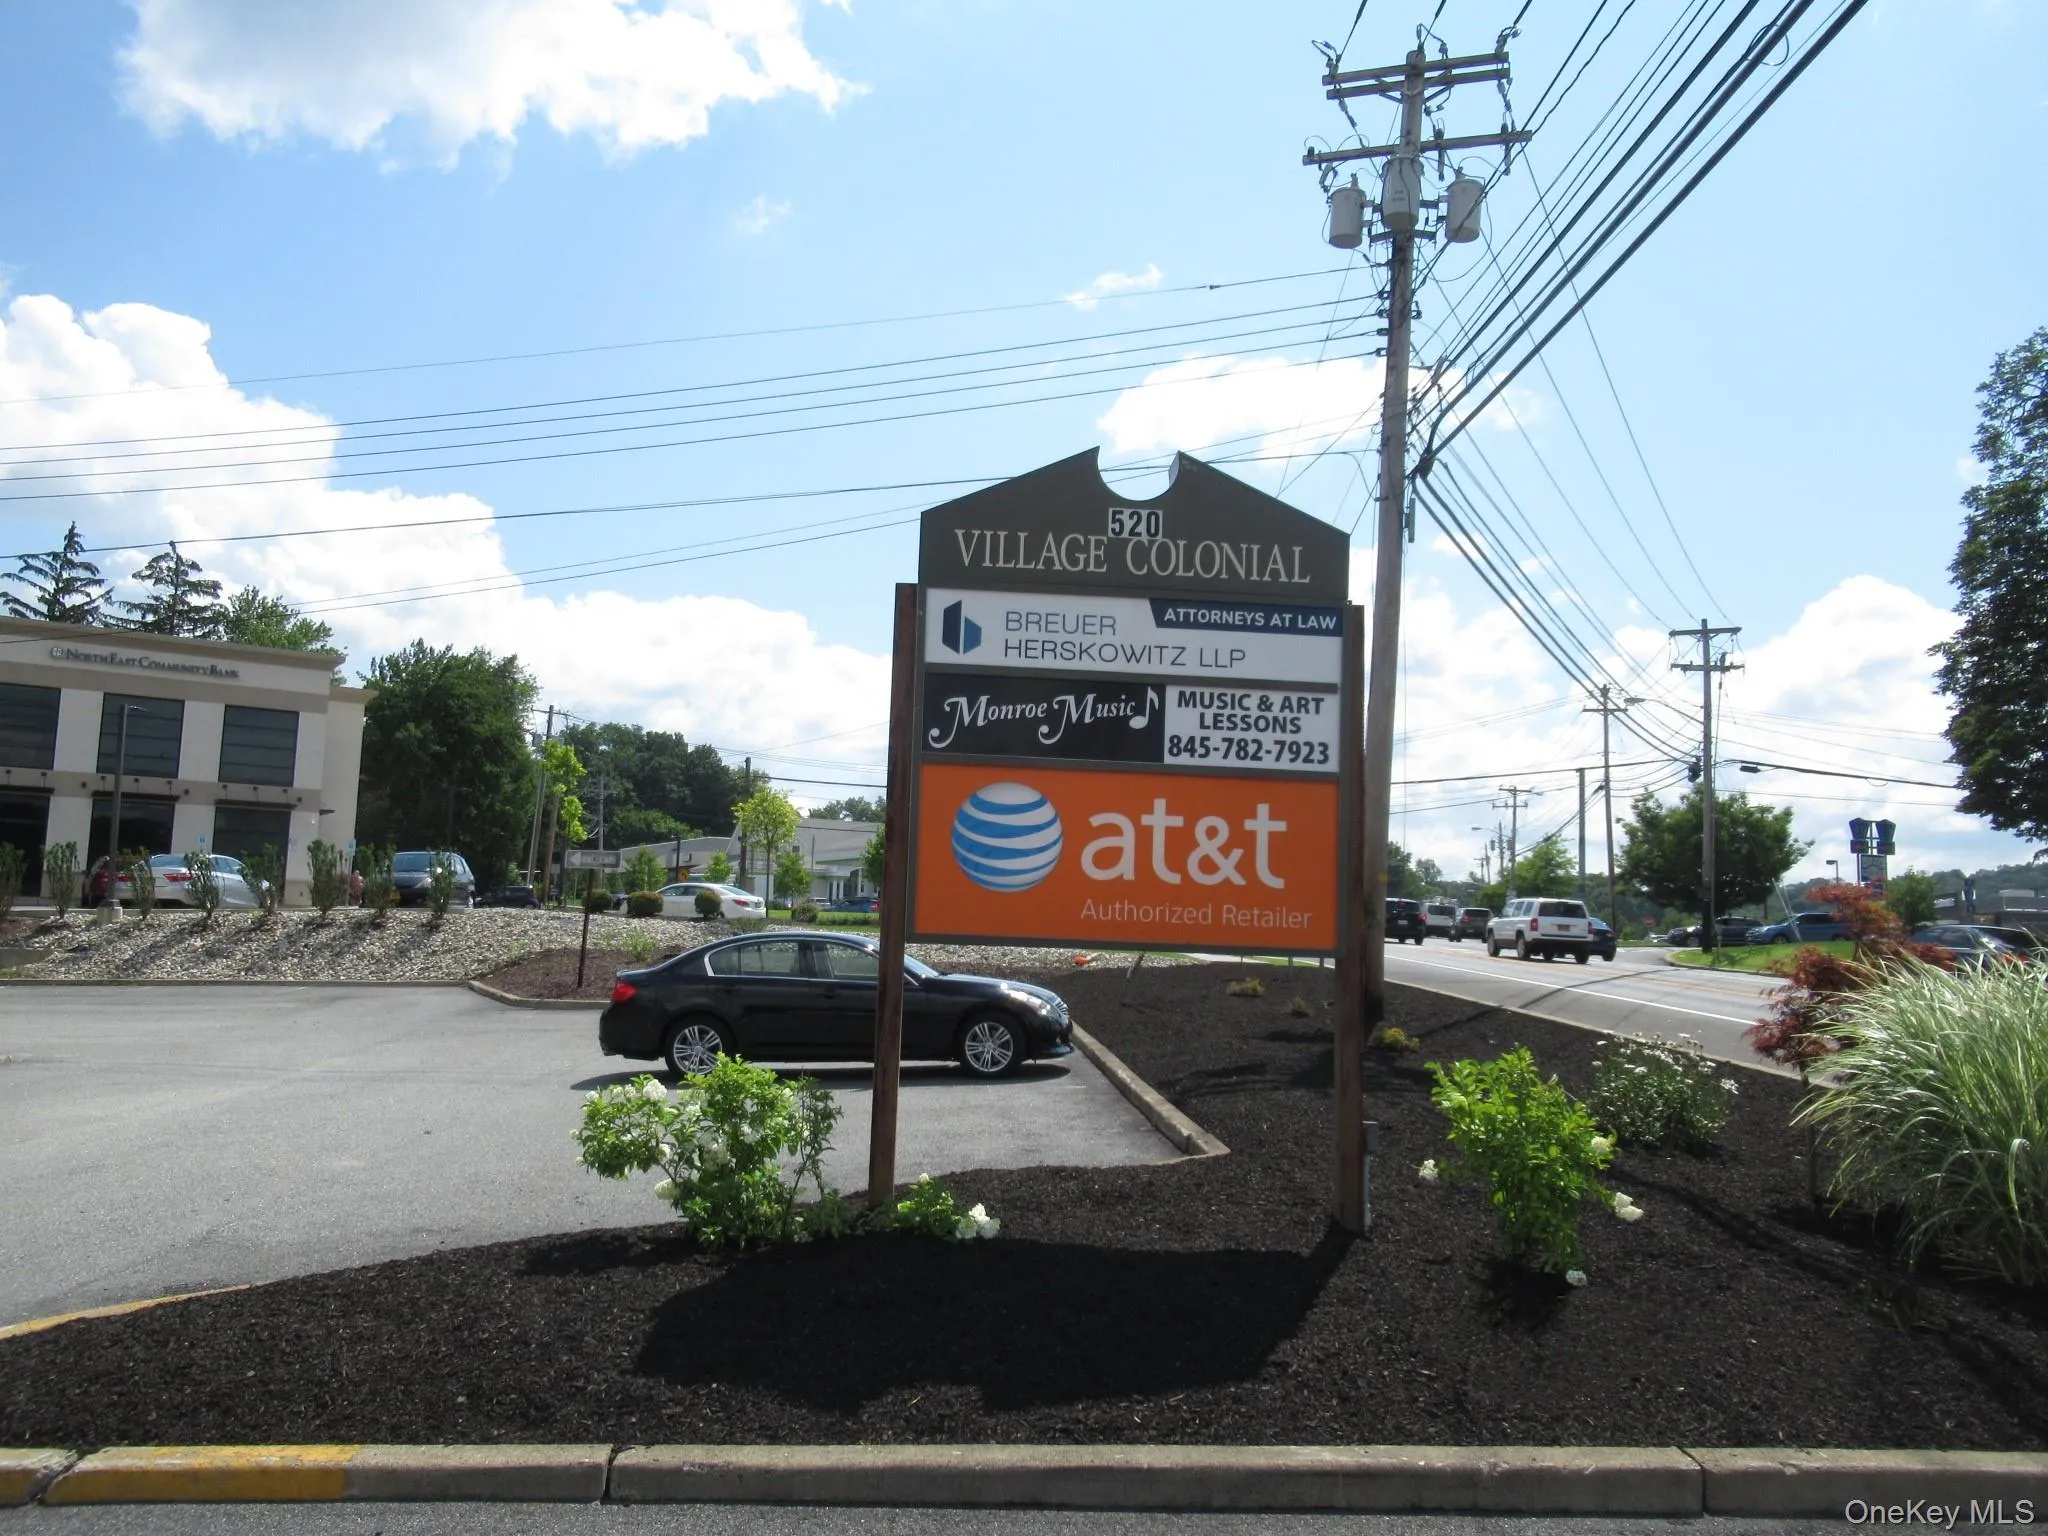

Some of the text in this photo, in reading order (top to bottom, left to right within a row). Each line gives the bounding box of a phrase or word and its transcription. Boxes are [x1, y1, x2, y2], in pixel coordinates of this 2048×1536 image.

[1110, 509, 1161, 538] 520
[956, 530, 1310, 583] VILLAGE COLONIAL
[1005, 611, 1116, 636] BREUER
[1164, 607, 1337, 630] ATTORNEYS AT LAW
[1004, 640, 1246, 667] HERSKOWITZ LLP
[1178, 690, 1325, 714] MUSIC & ART
[928, 693, 1136, 749] Monroe Music
[1198, 712, 1302, 735] LESSONS
[1168, 735, 1330, 765] 845-782-7923
[1080, 798, 1288, 889] at&t
[1080, 899, 1312, 929] Authorized Retailer
